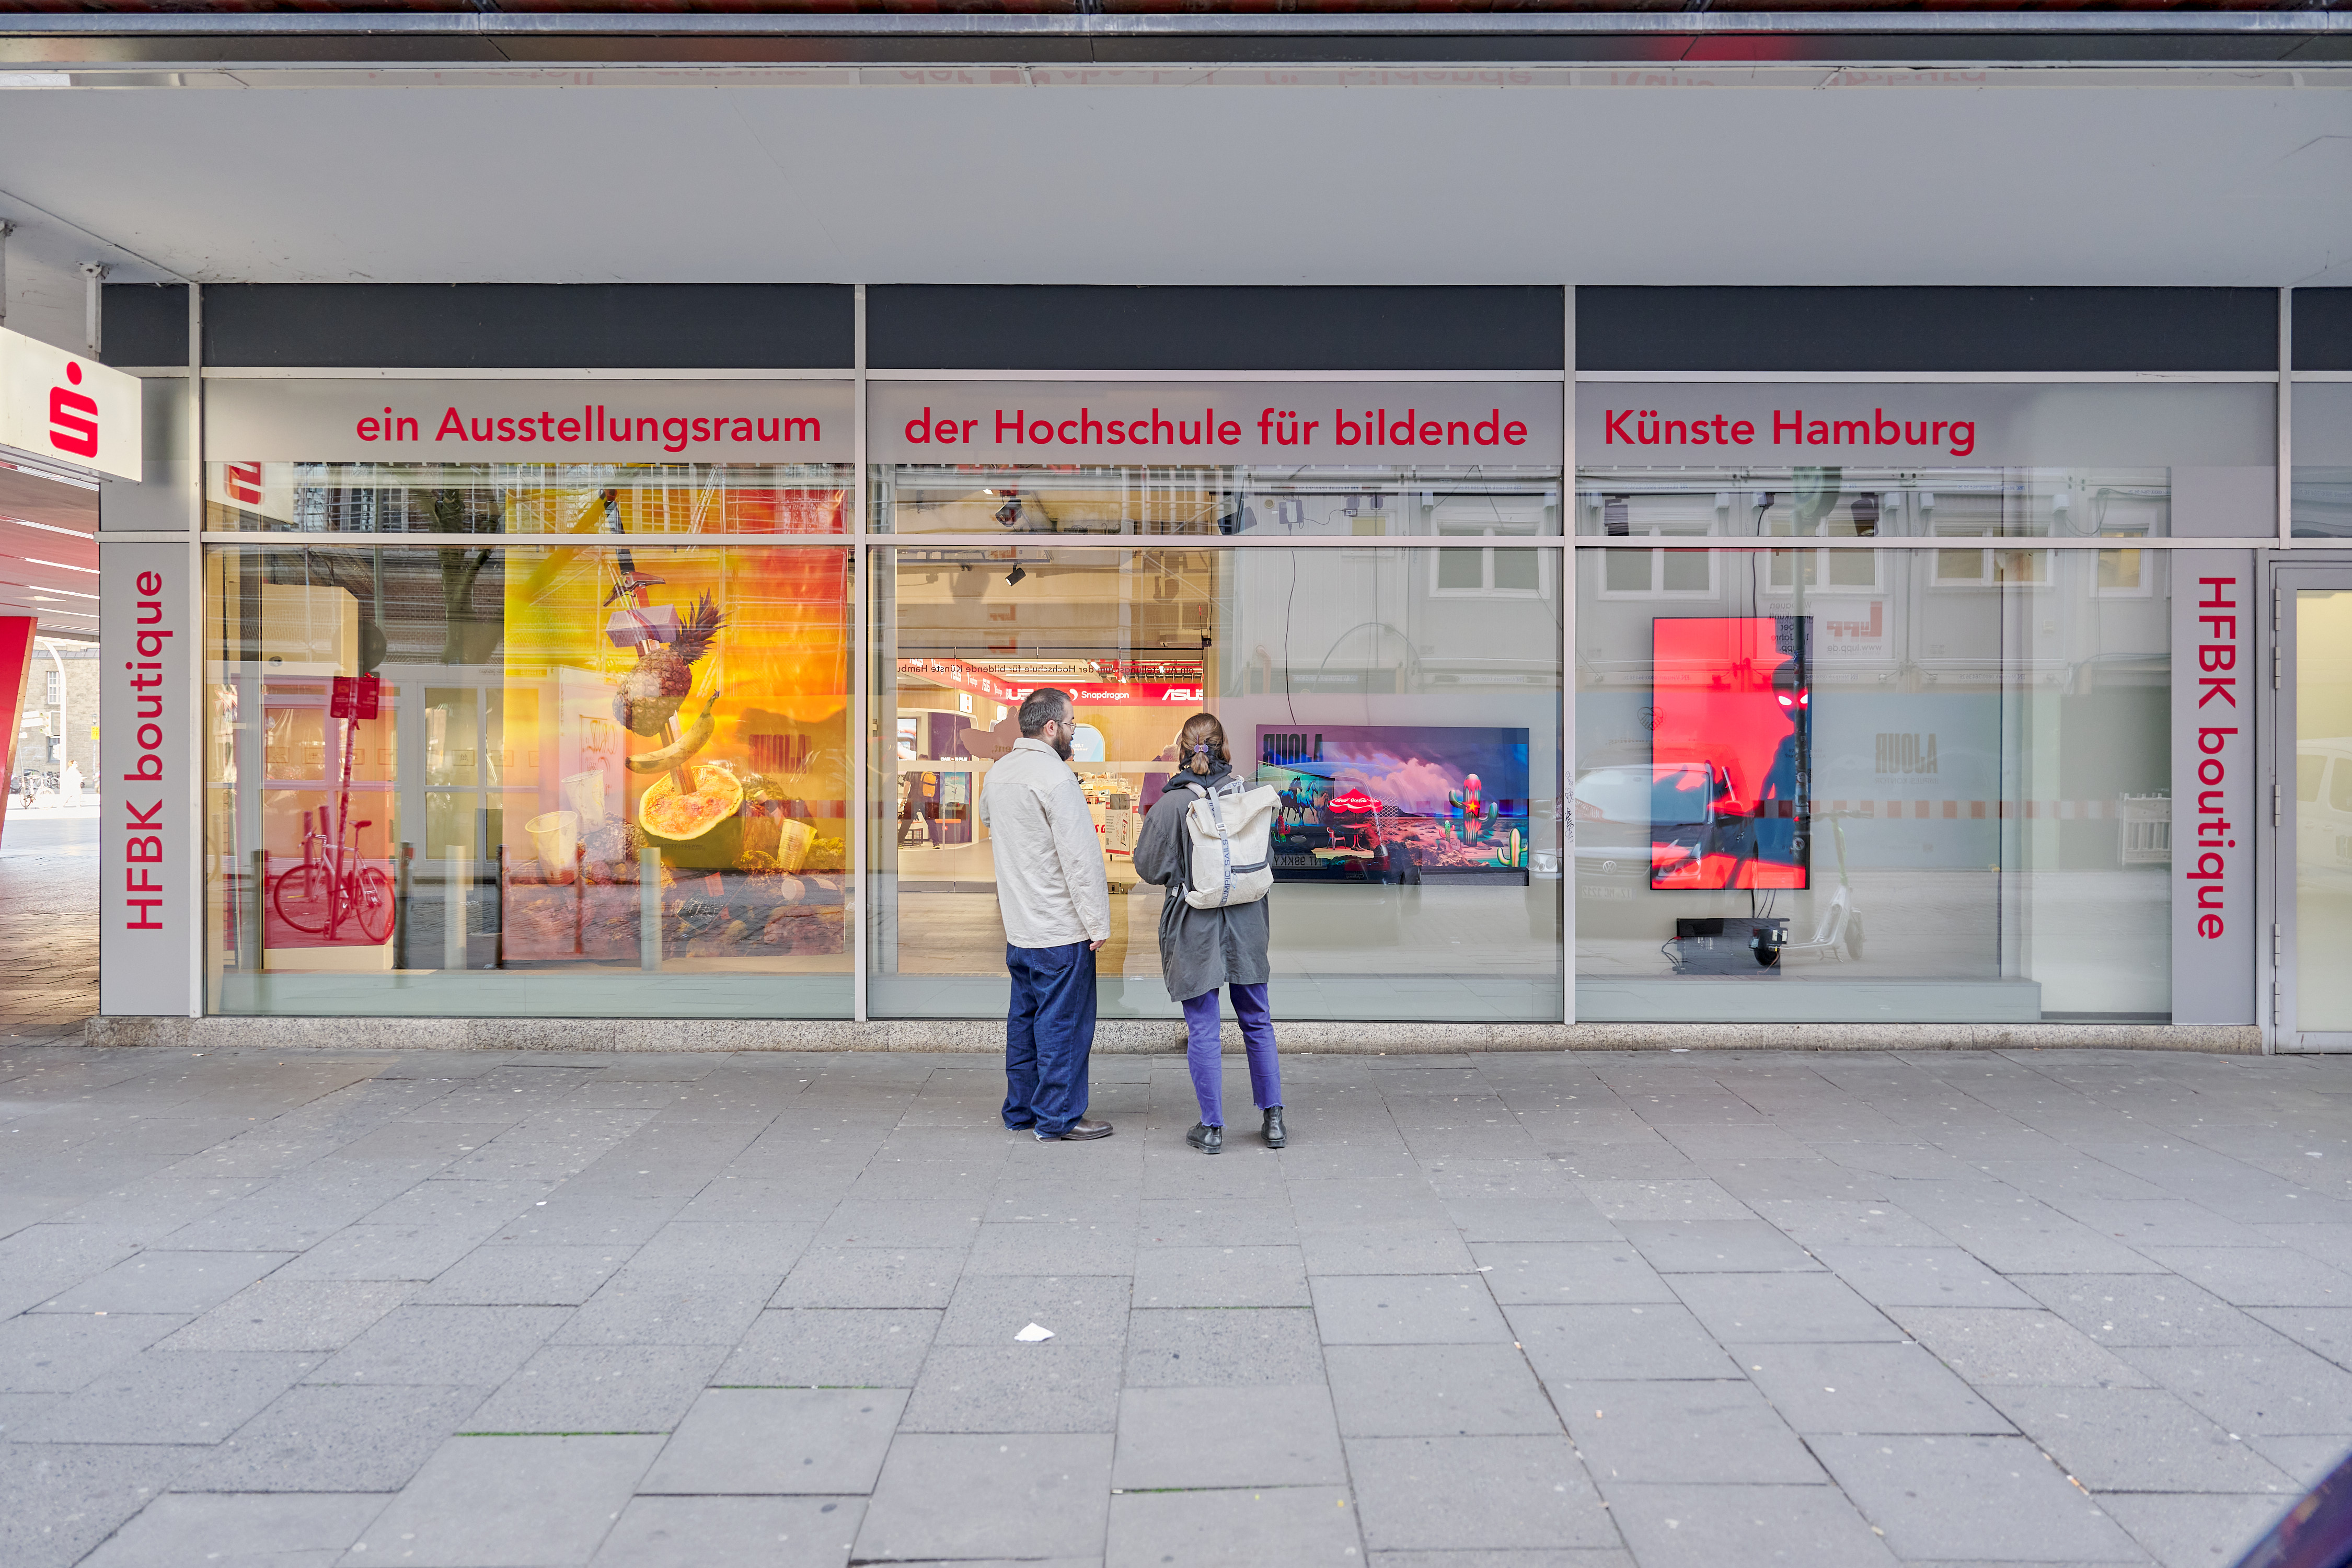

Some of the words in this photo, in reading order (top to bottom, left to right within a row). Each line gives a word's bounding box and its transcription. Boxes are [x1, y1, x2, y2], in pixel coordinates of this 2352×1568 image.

[356, 407, 418, 442] ein
[435, 405, 820, 453] Ausstellungsraum
[905, 407, 978, 444] der
[995, 408, 1241, 445] Hochschule
[1257, 408, 1319, 445] für
[1336, 408, 1527, 446] bildende
[1606, 410, 1755, 445] Künste
[1773, 408, 1975, 457] Hamburg
[2199, 578, 2236, 709] HFBK
[123, 571, 173, 781] boutique
[1081, 690, 1129, 700] Snapdragon
[1222, 838, 1231, 866] SAILS
[2186, 728, 2238, 939] boutique
[126, 800, 163, 929] HFBK
[1221, 870, 1231, 903] OLIMPIC
